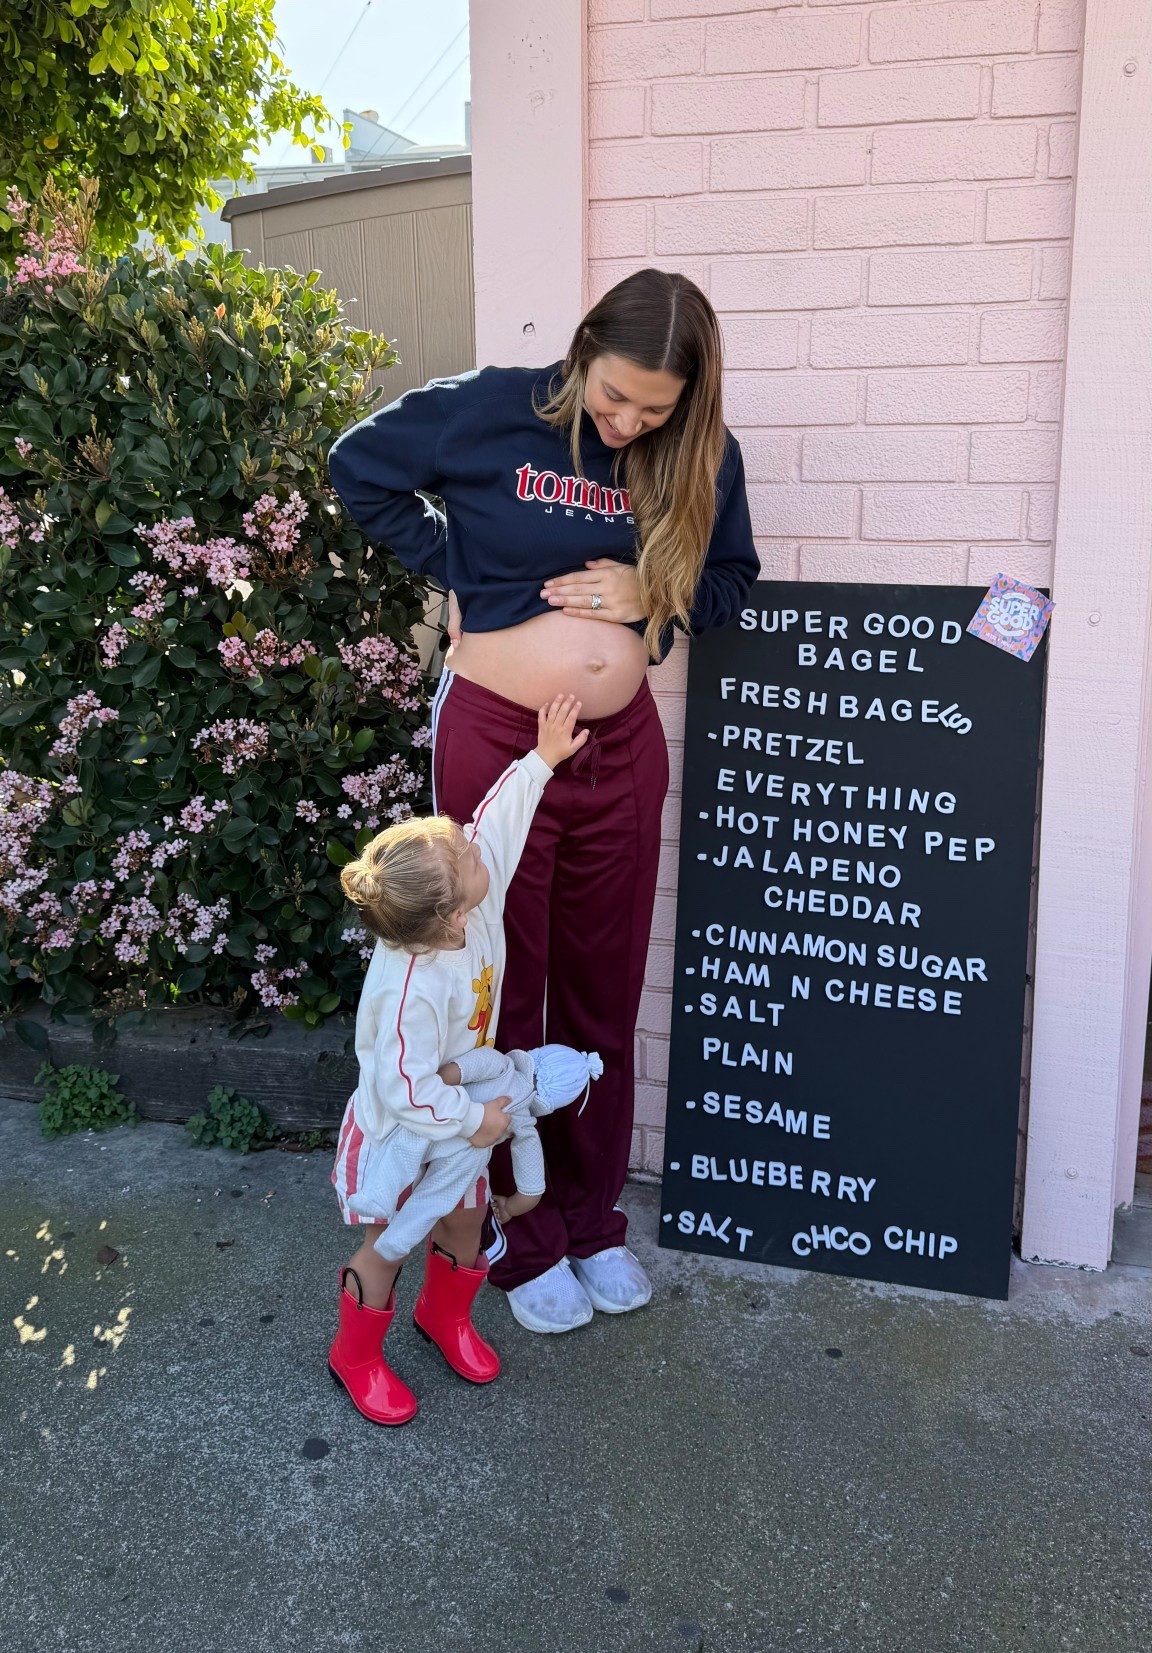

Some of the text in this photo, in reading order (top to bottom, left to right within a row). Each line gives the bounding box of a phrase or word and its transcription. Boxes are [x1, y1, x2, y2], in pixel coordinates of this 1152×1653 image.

[545, 506, 635, 524] JEANS
[739, 608, 849, 640] SUPER
[863, 612, 962, 645] GOOD
[987, 610, 1033, 631] GOOD
[989, 597, 1040, 621] SUPER
[798, 643, 924, 673] BAGEL
[720, 677, 973, 735] FRESH BAGELS
[722, 725, 864, 765] PRETZEL
[717, 768, 957, 814] EVERYTHING
[716, 805, 996, 862] HOT HONEY PEP
[712, 845, 901, 888] JALAPENO
[764, 885, 922, 928] CHEDDAR
[705, 923, 988, 982] CINNAMON SUGAR
[701, 955, 963, 1015] HAM N CHEESE
[699, 992, 785, 1027] SALT
[703, 1037, 793, 1076] PLAIN
[702, 1091, 831, 1139] SESAME
[691, 1154, 876, 1203] BLUEBERRY
[677, 1210, 958, 1260] SALT CHCO CHIP
